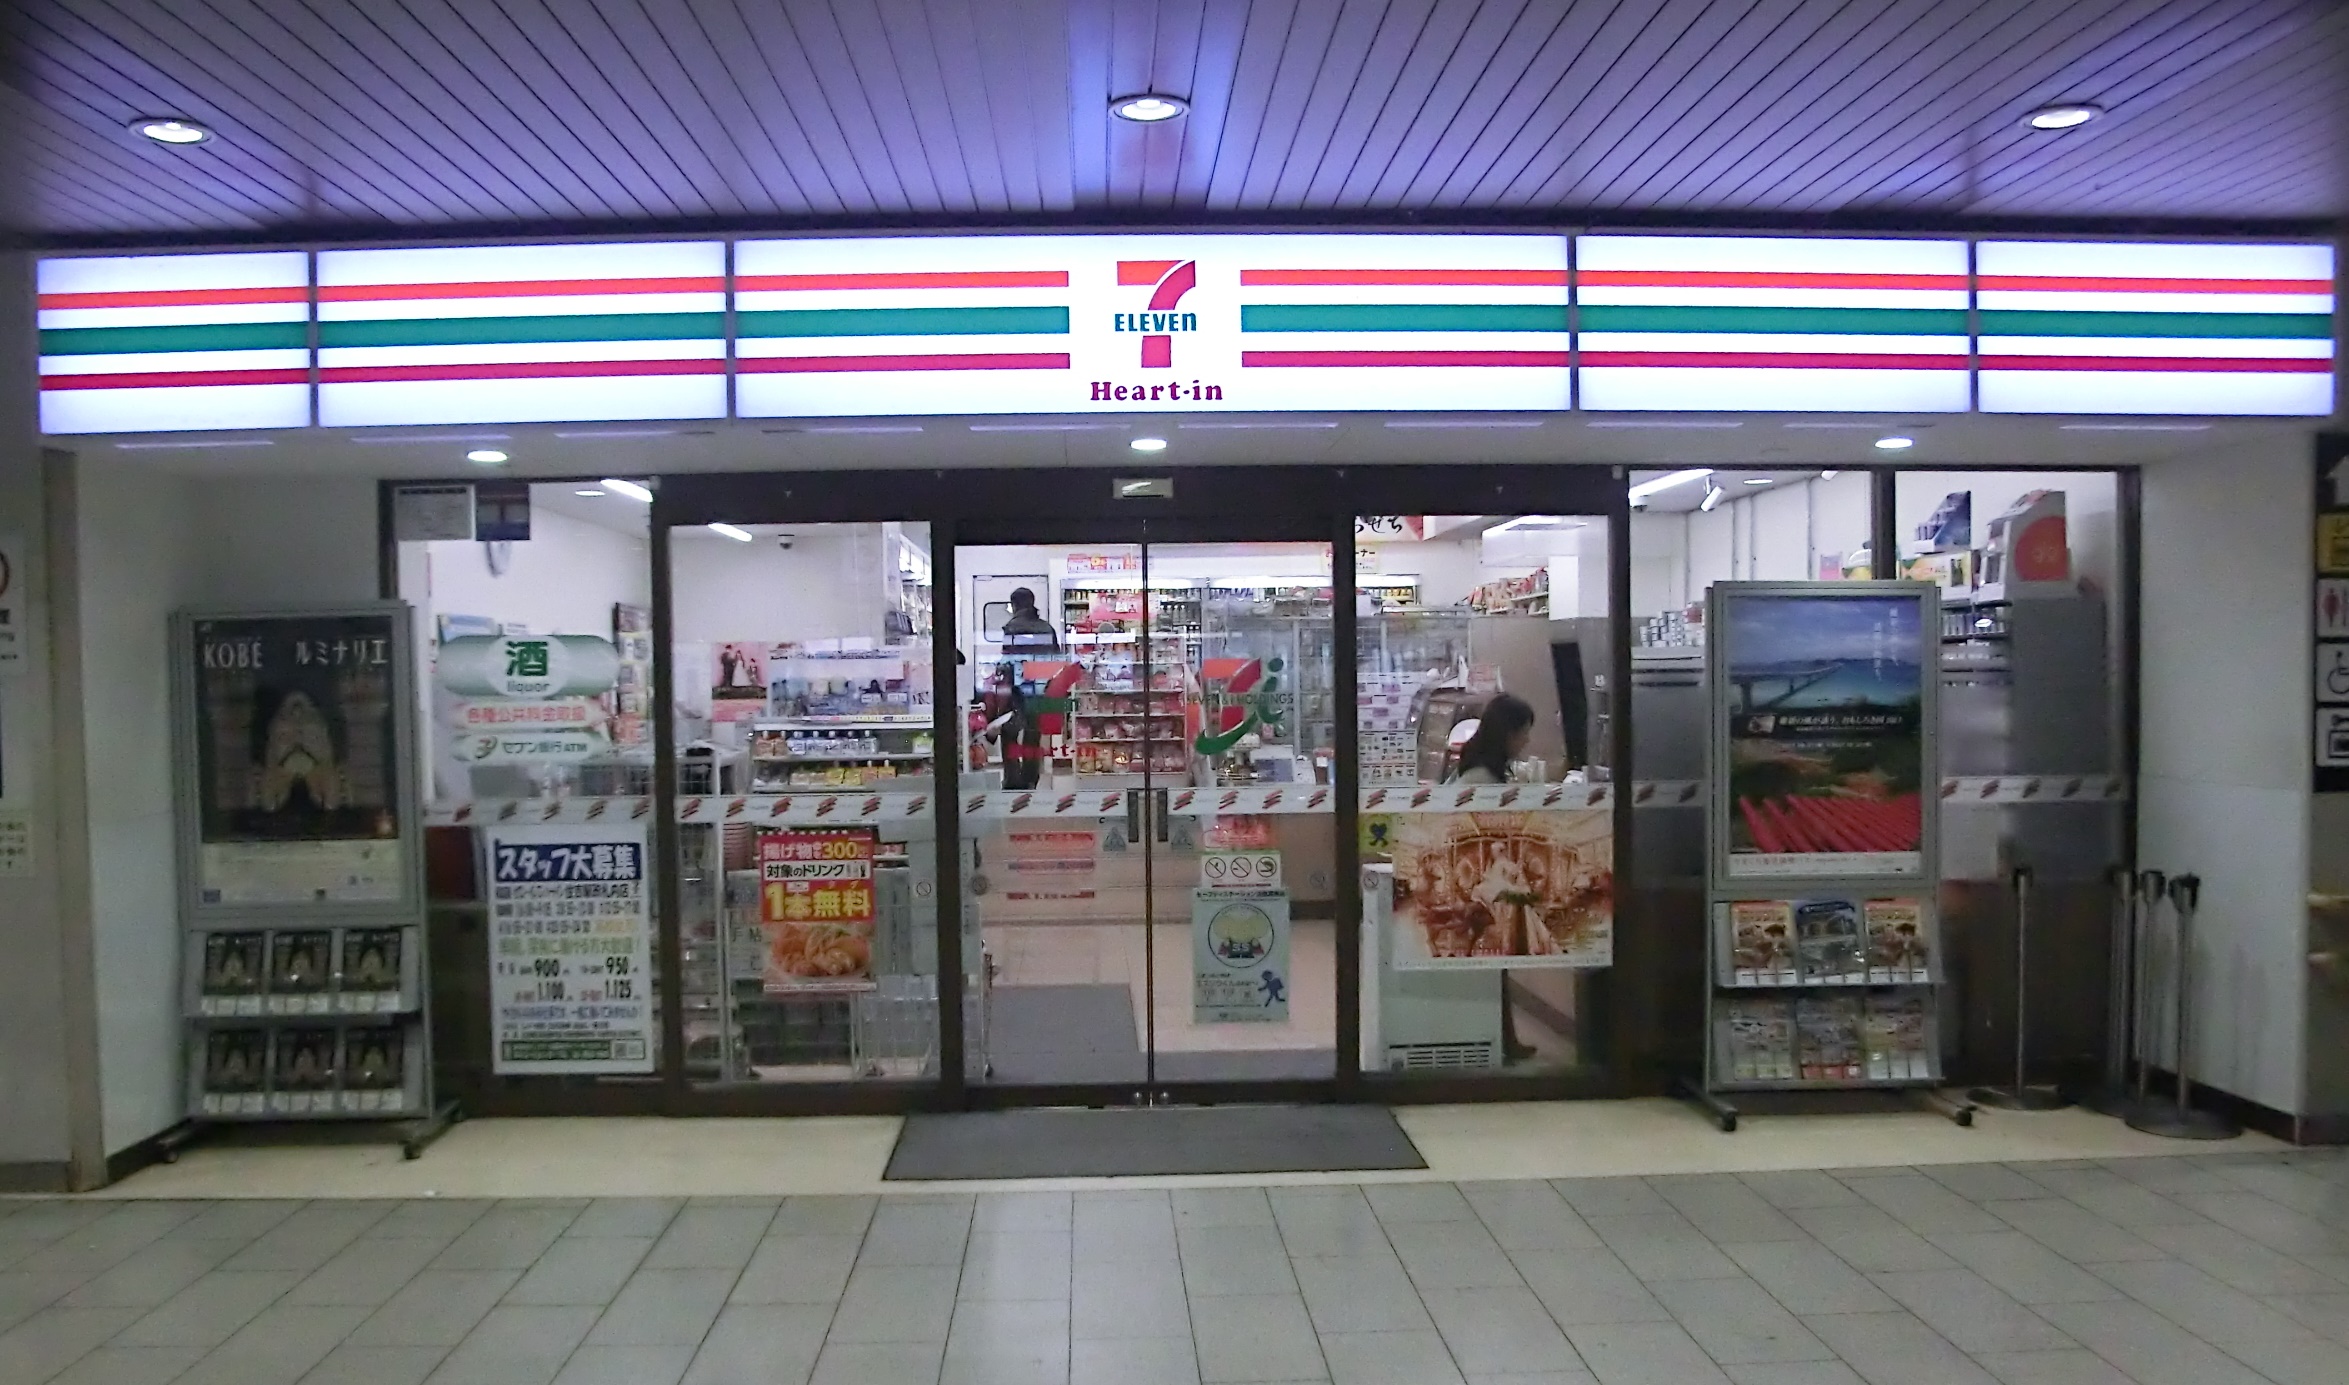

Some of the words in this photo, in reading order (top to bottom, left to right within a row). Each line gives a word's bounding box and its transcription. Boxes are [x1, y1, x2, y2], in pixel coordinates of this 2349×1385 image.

[1090, 379, 1223, 401] Heart-in
[295, 638, 389, 666] ルミナリエ
[506, 641, 549, 676] 酒
[507, 680, 550, 693] liquor
[498, 844, 637, 880] スタッフ大募集
[766, 864, 845, 878] 対象のドリンク
[764, 881, 872, 921] 1本無料
[534, 959, 560, 977] 900
[606, 956, 629, 975] 950
